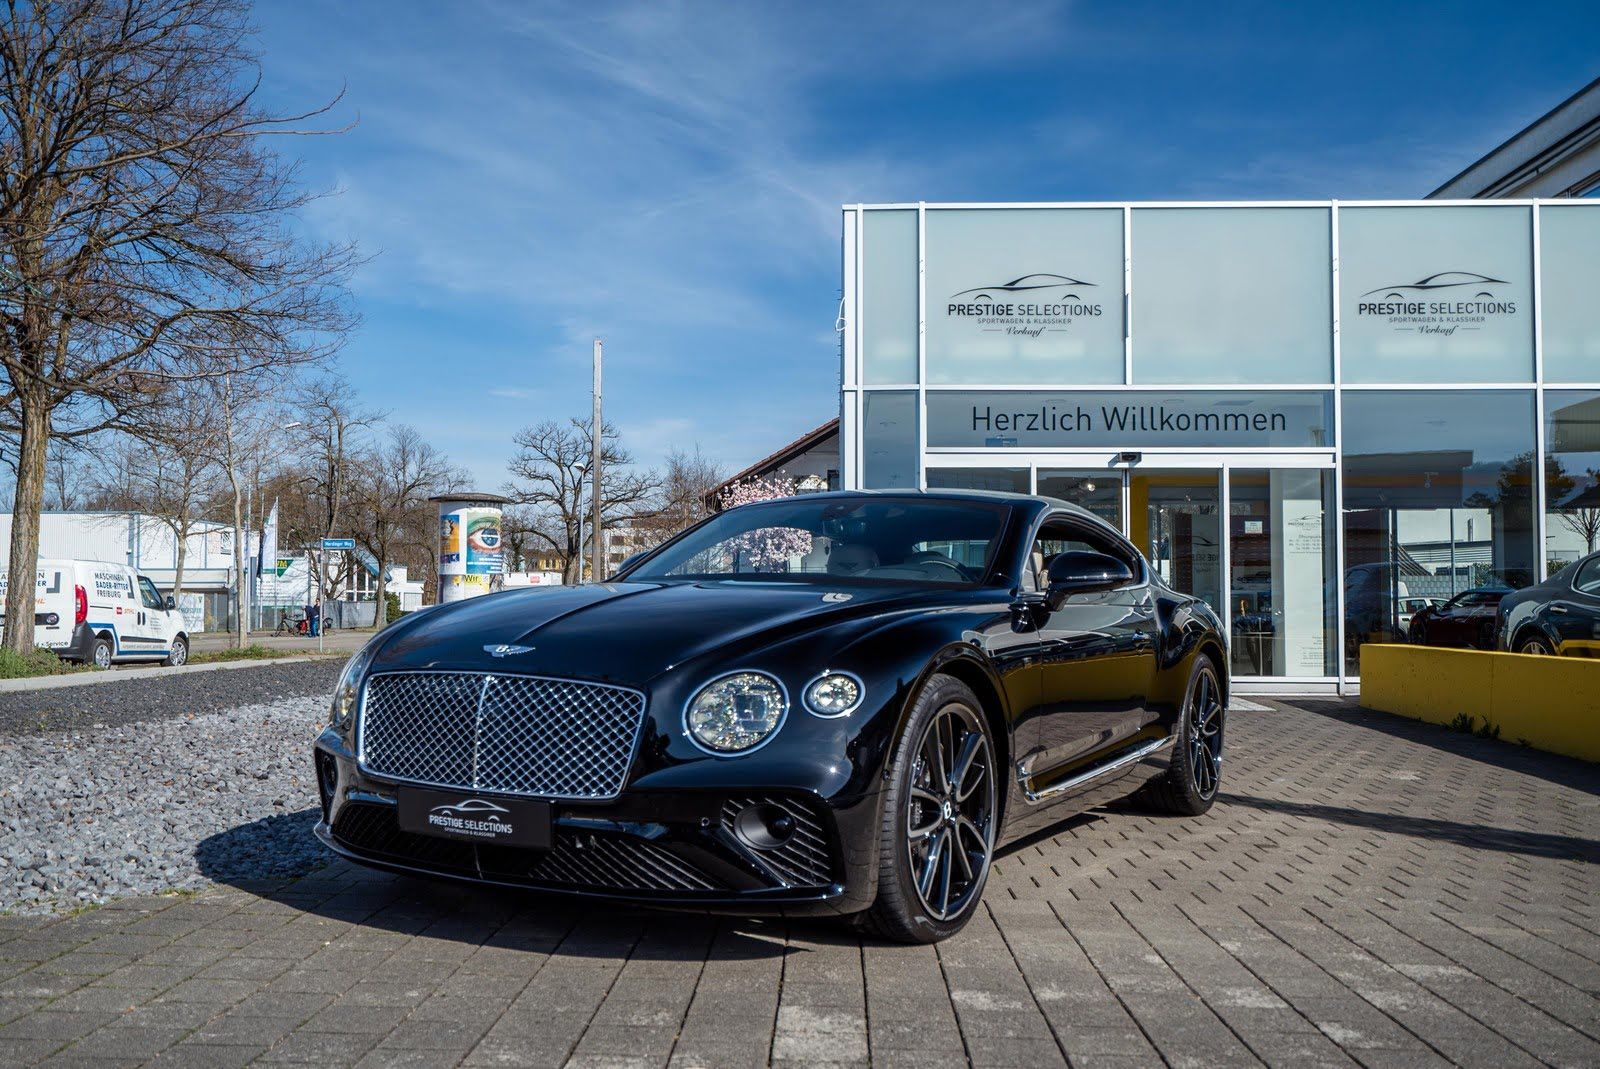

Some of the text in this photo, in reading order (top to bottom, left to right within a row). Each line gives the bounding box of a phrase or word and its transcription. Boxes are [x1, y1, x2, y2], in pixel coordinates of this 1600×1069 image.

[948, 304, 1102, 316] PRESTIGE SELECTIONS
[1359, 302, 1516, 315] PRESTIGE SELECTIONS
[1006, 326, 1046, 338] Verkauf
[1418, 325, 1459, 336] Verkauf
[972, 406, 1286, 431] Herzlich Willkommen
[94, 572, 124, 581] MASCHINEN
[95, 581, 129, 591] BADER-RITTER
[96, 589, 121, 598] FREIBURG
[429, 815, 513, 834] PRESTIGE SELECTIONS
